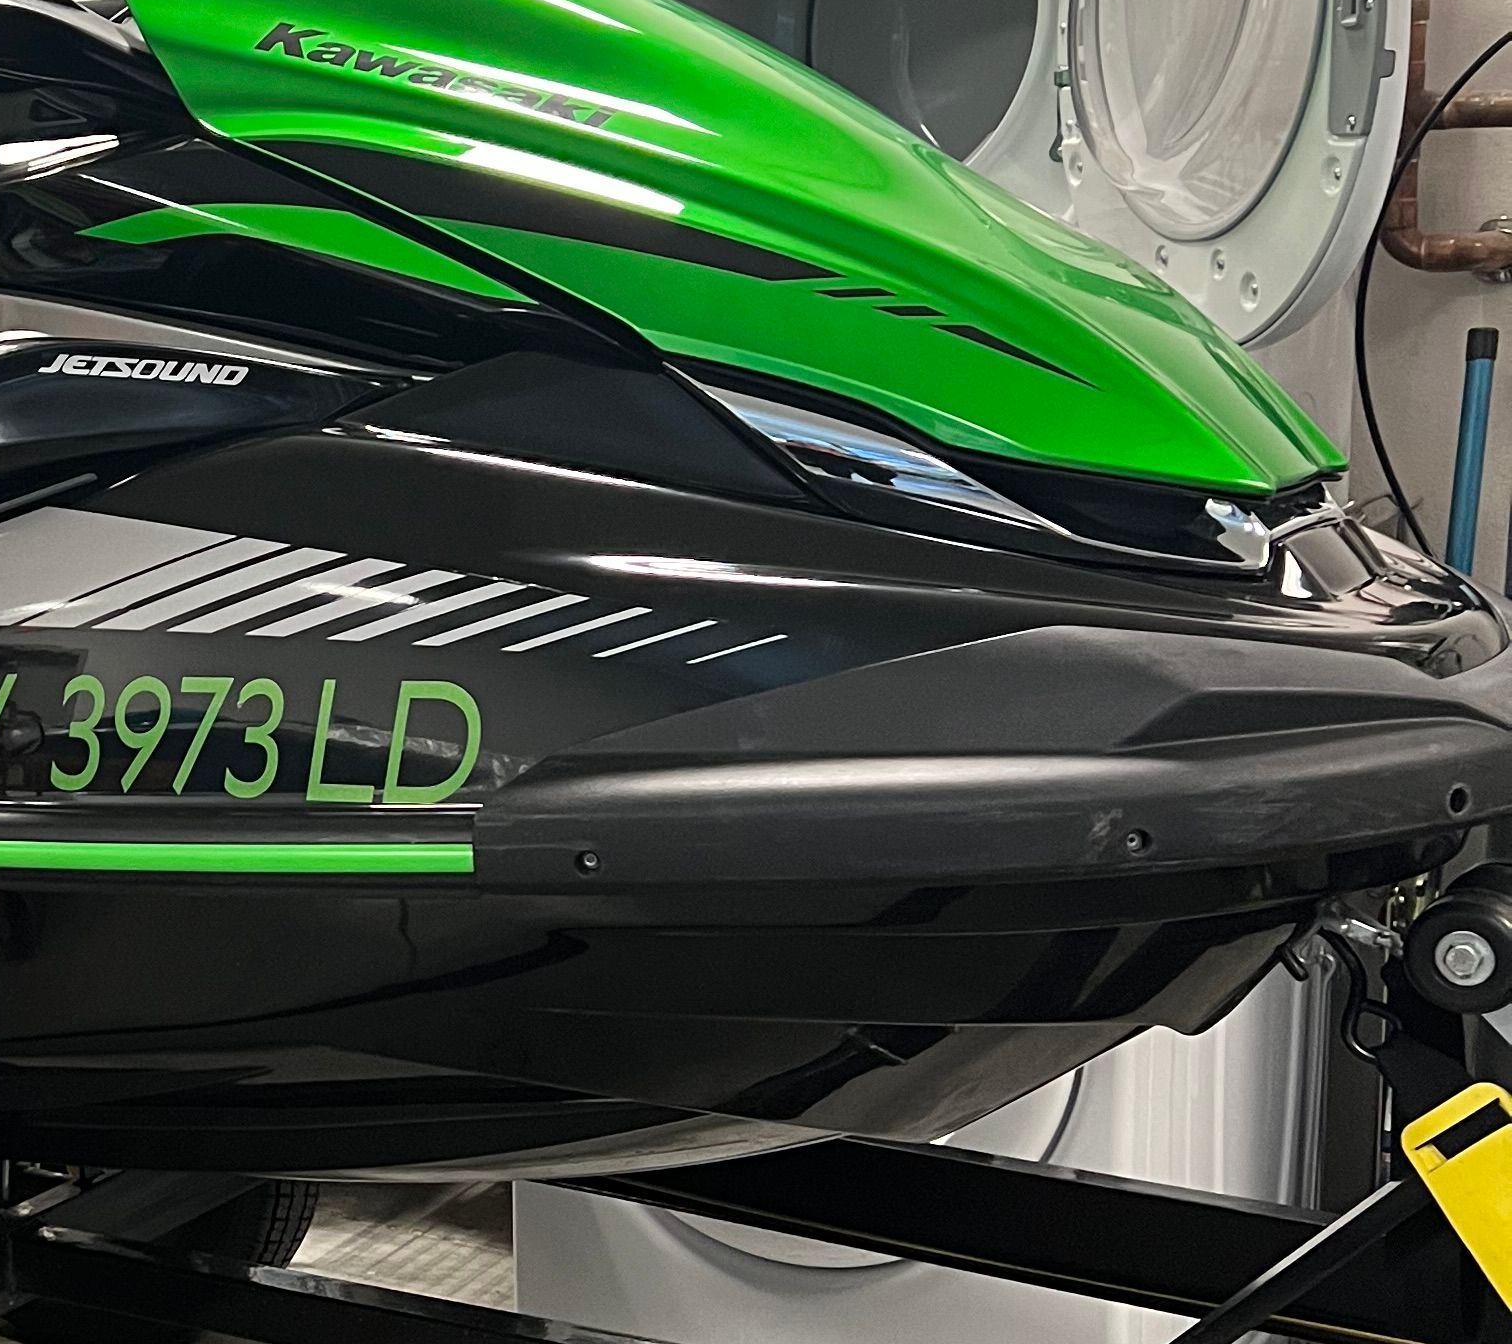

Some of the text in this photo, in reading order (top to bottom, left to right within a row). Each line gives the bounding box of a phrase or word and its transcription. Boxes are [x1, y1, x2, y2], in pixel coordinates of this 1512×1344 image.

[254, 22, 616, 128] Kawasaki
[38, 353, 249, 386] JETSOUND
[50, 674, 285, 799] 3973
[306, 678, 482, 804] LD
